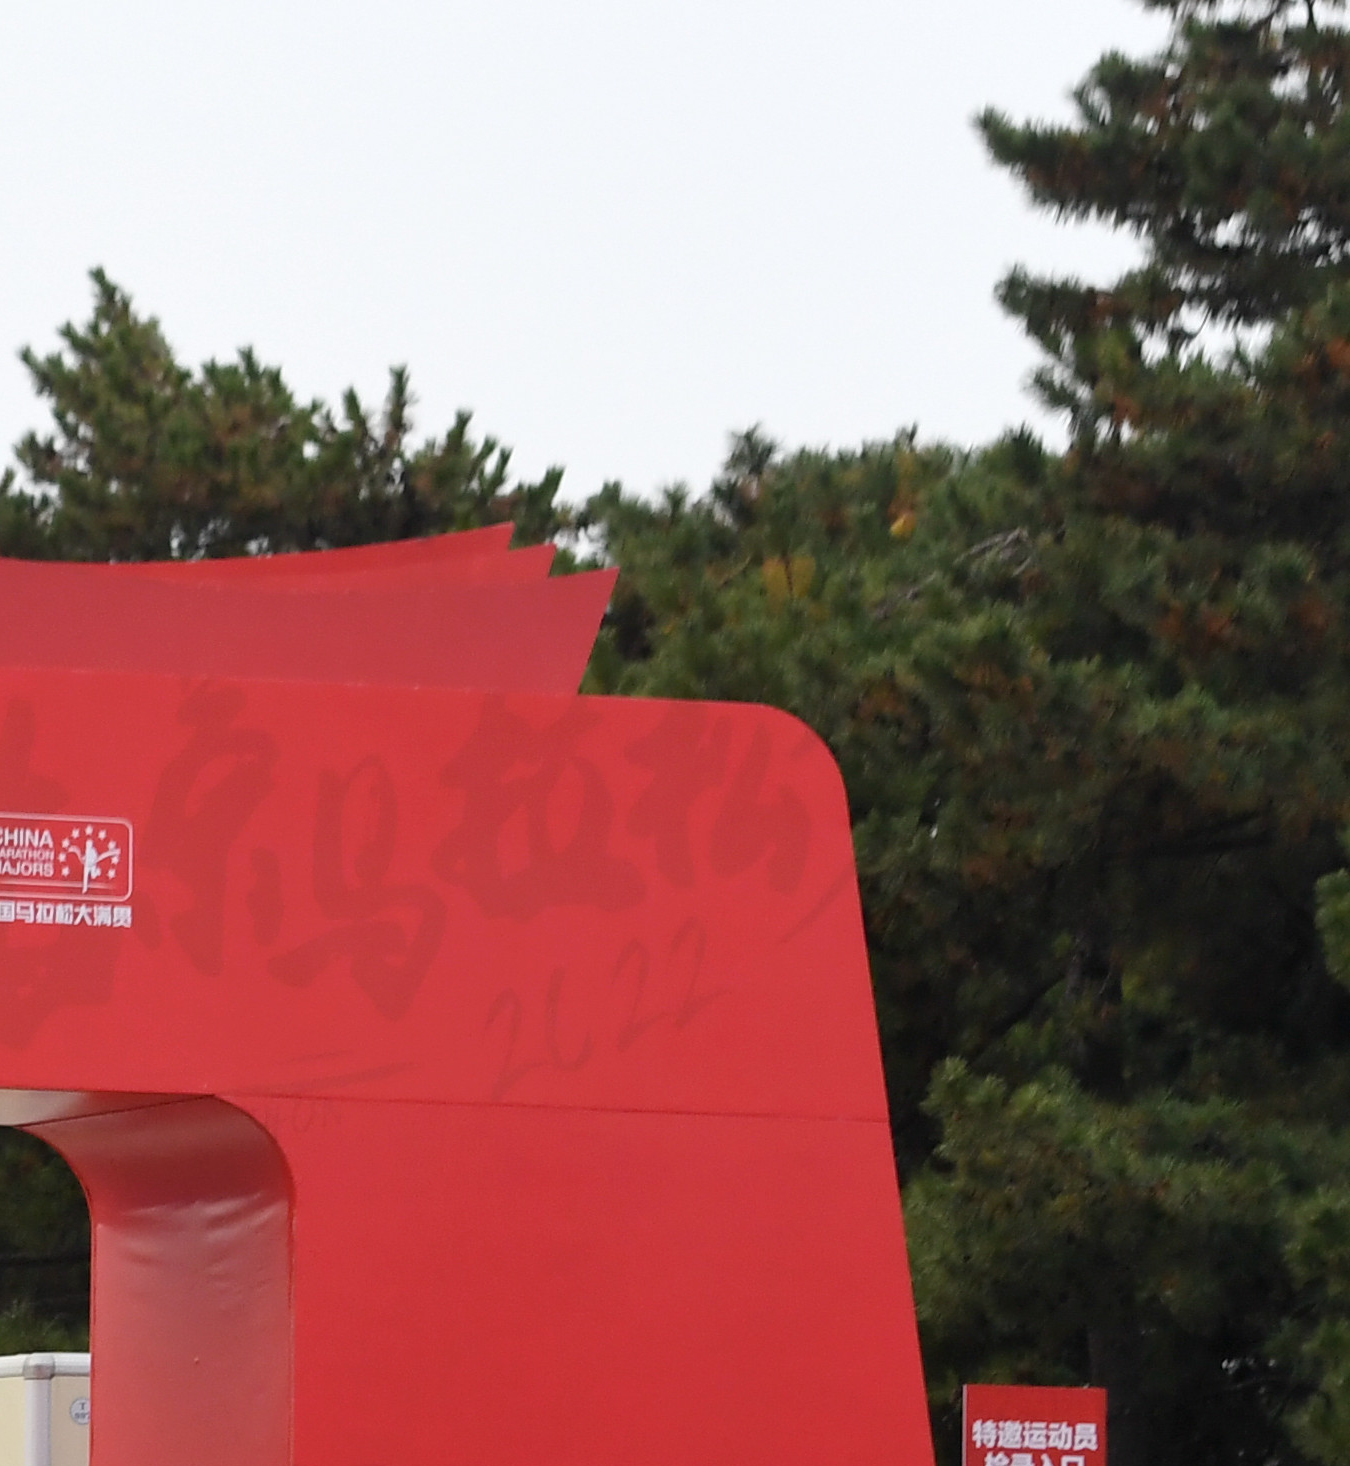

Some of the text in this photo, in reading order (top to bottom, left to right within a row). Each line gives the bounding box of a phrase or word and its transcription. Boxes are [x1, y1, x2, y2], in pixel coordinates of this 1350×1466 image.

[972, 1419, 1099, 1450] 特邀运动员
